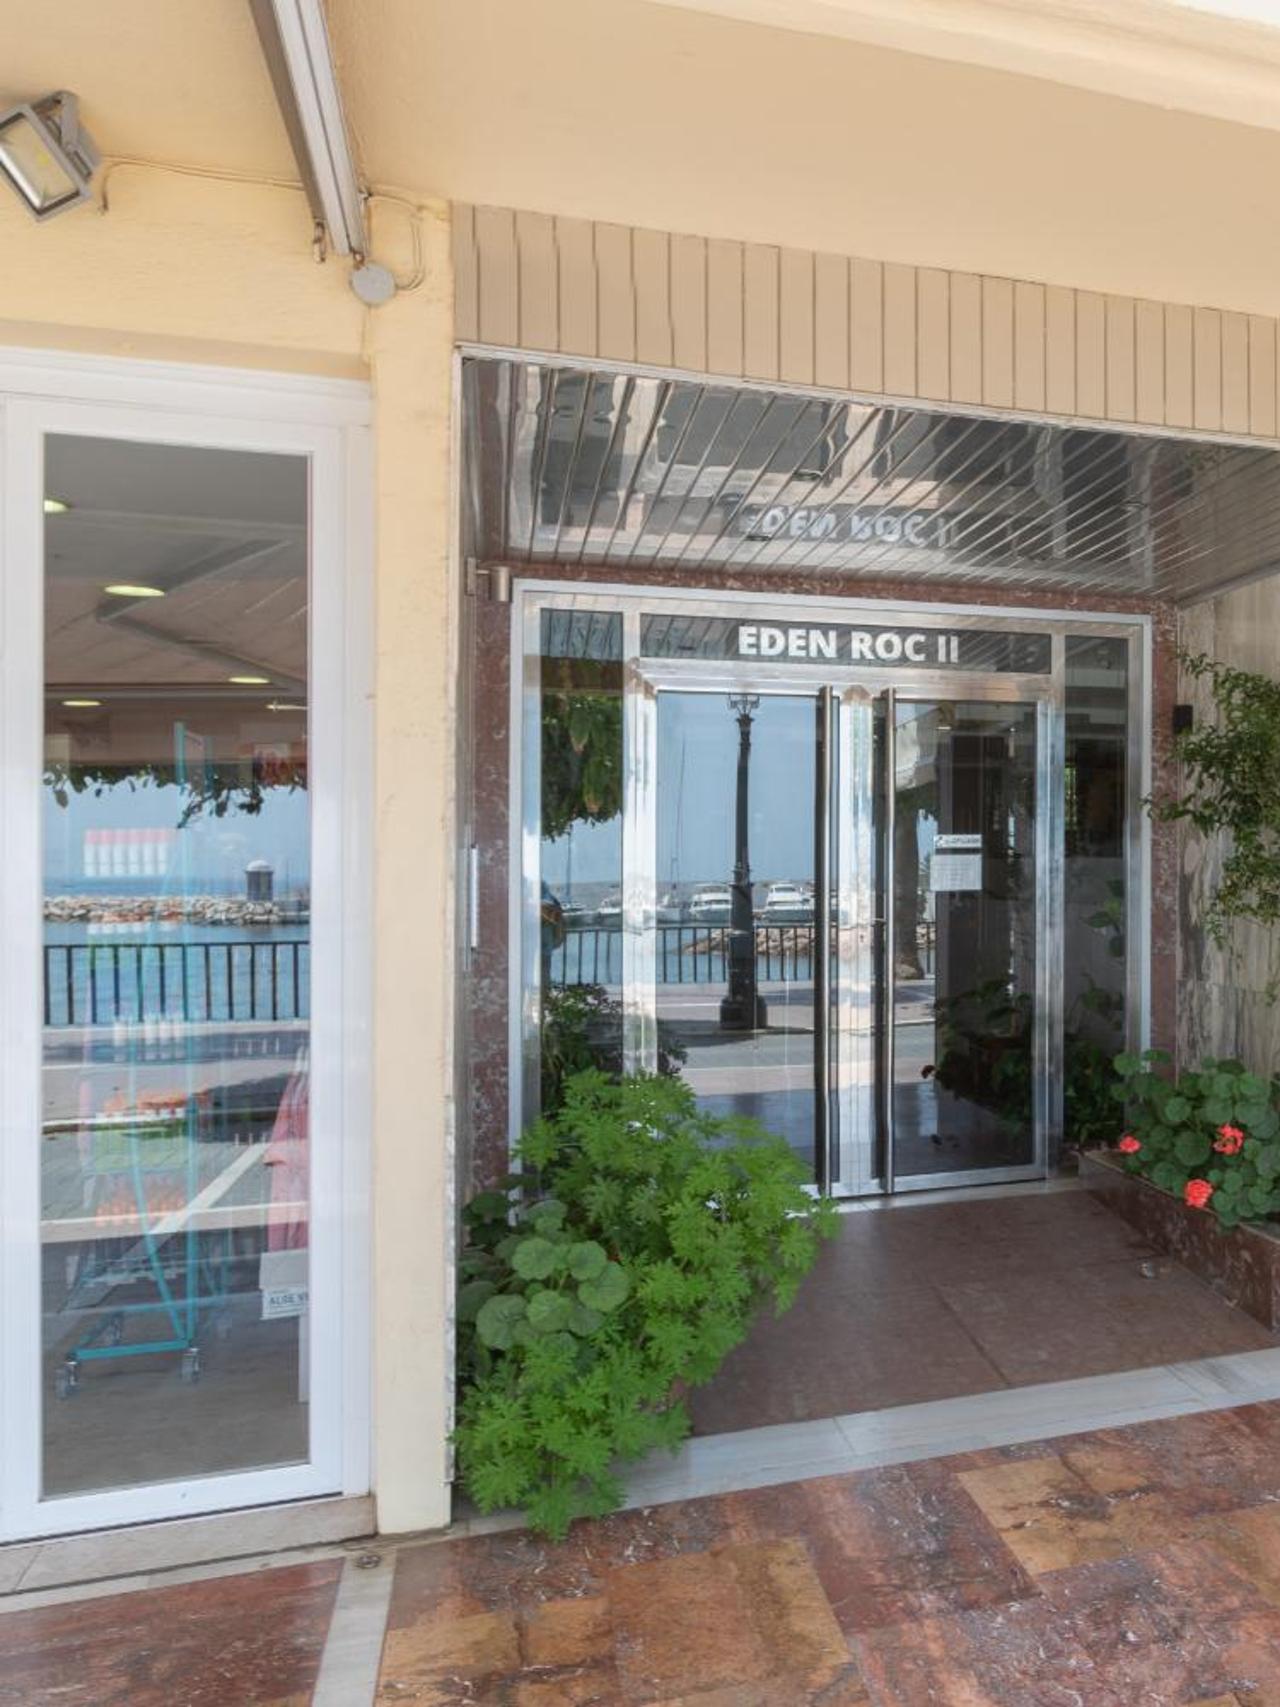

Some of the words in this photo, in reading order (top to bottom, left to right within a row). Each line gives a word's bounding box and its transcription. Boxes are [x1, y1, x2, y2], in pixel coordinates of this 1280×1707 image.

[738, 626, 837, 658] EDEN
[851, 631, 926, 661] ROC
[938, 635, 958, 663] II
